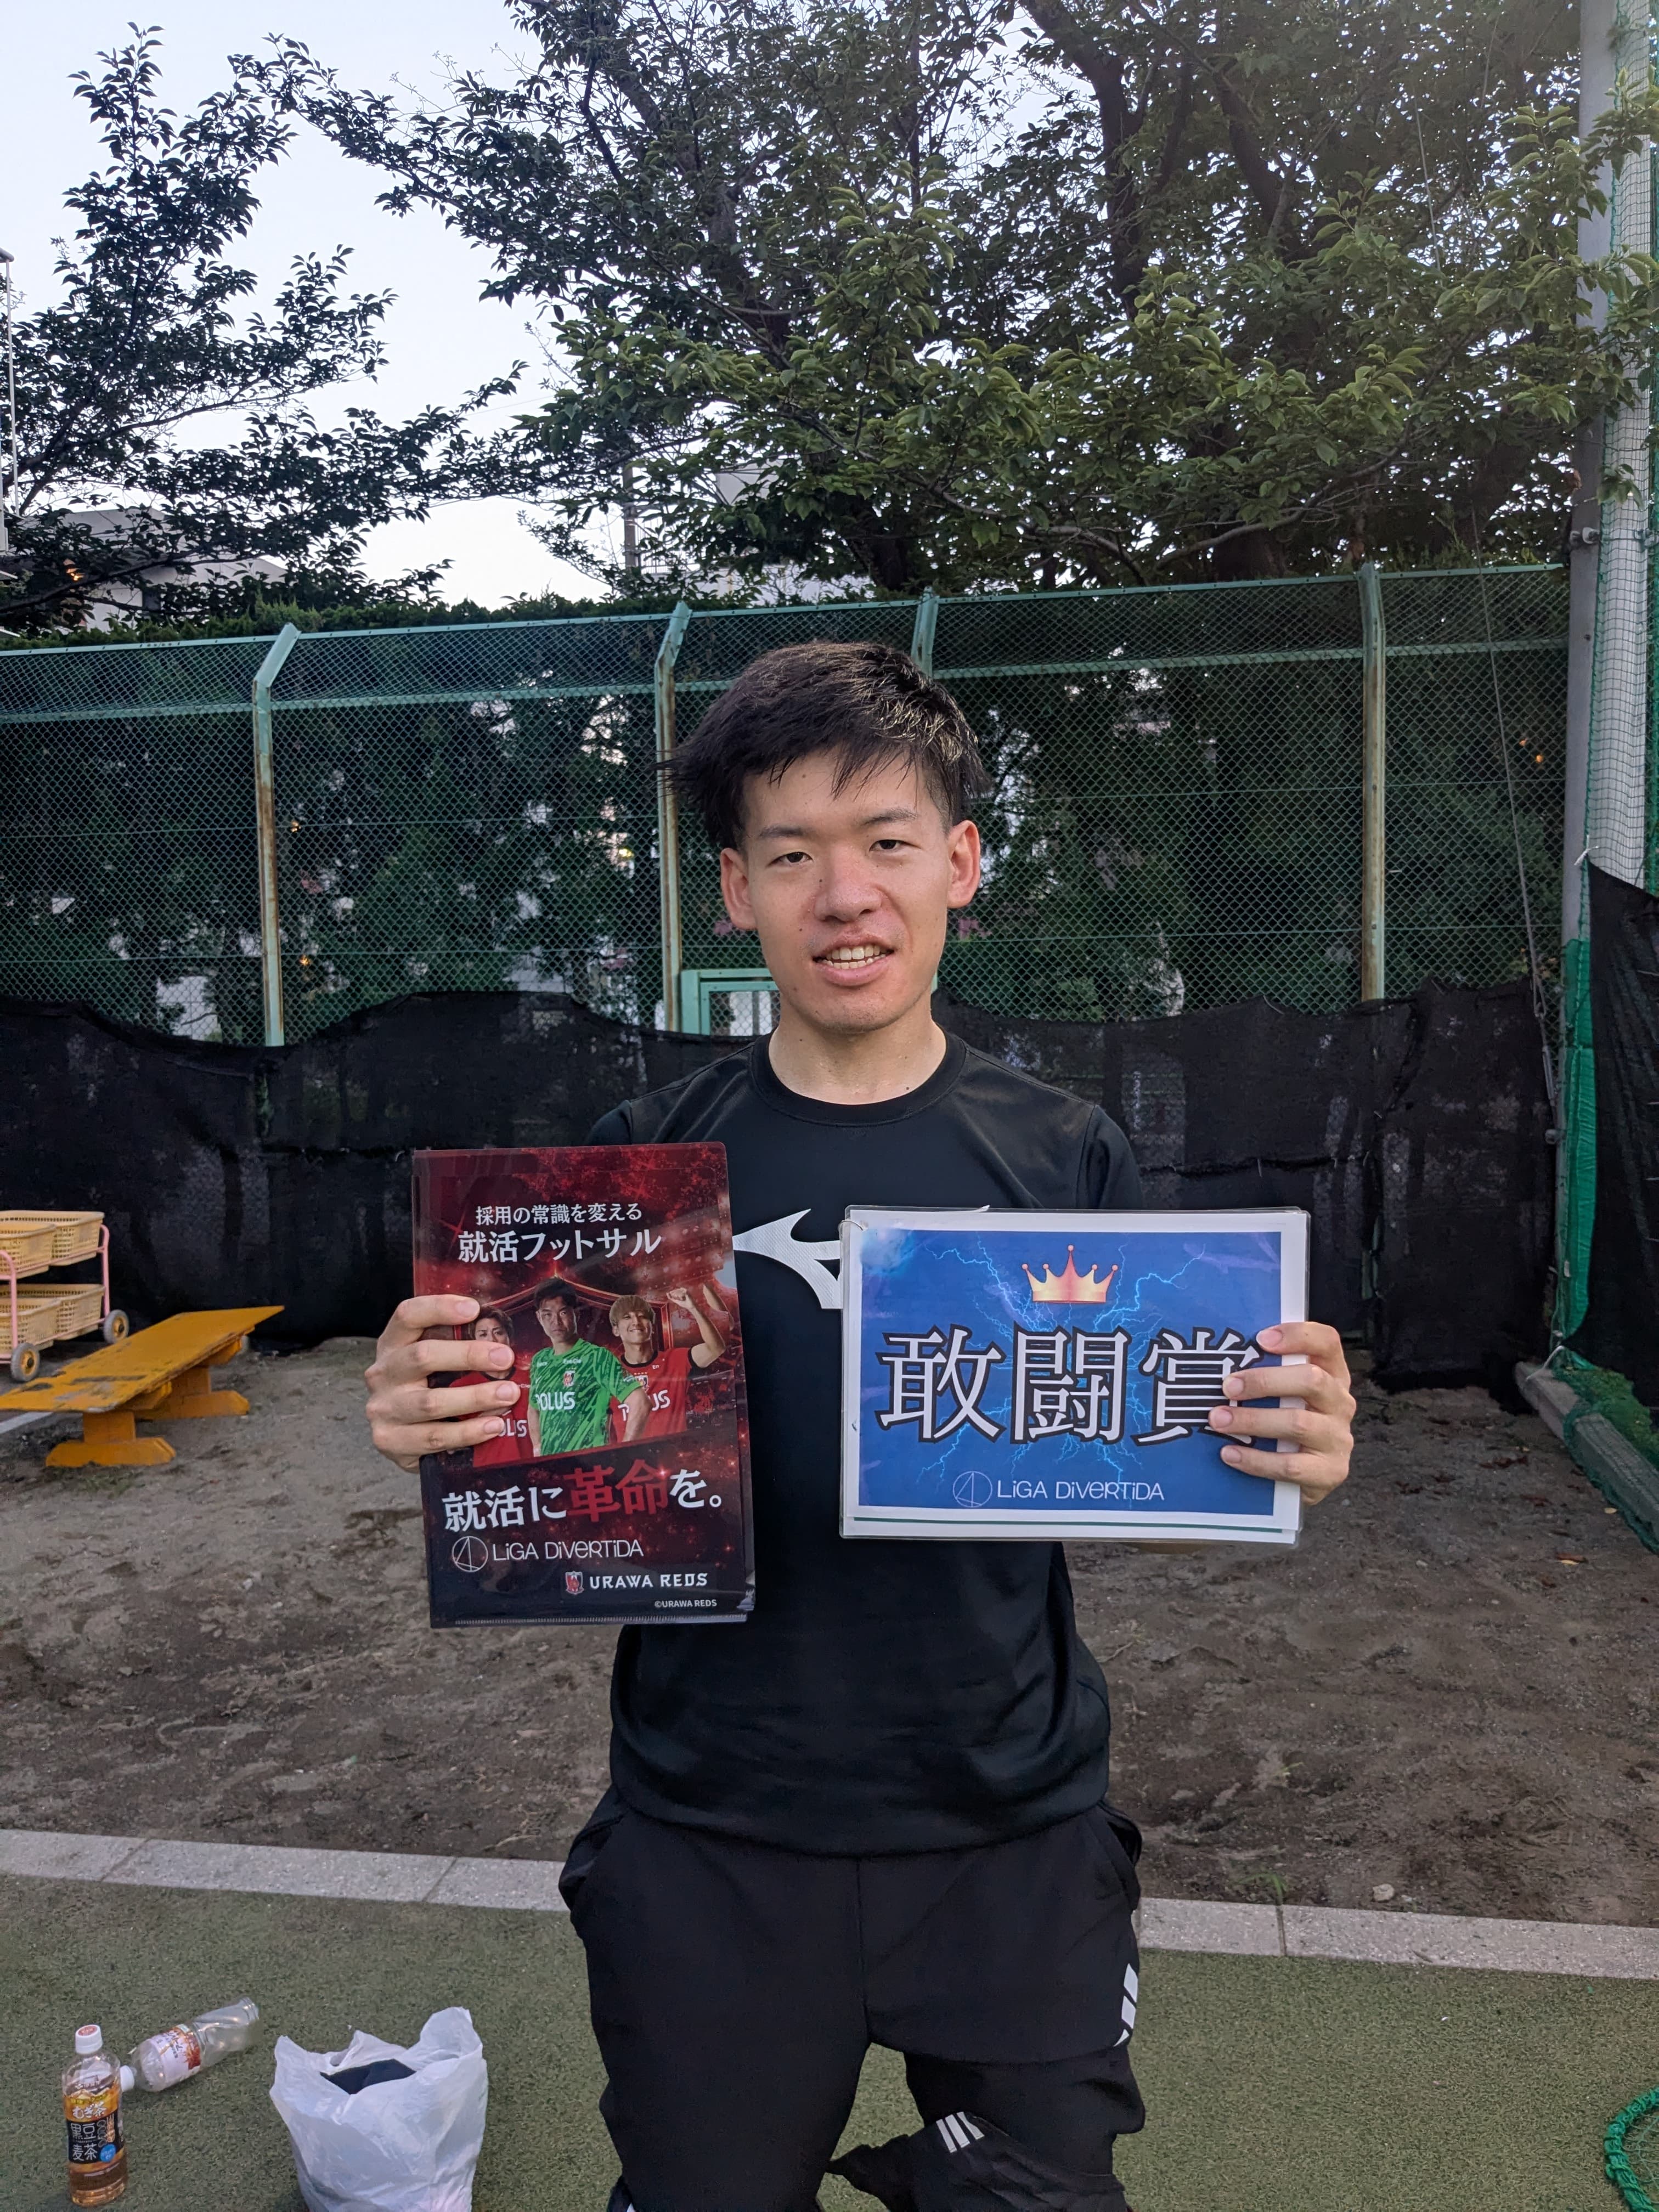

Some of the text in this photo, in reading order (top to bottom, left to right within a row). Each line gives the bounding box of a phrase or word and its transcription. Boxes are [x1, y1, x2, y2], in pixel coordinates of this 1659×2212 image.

[476, 1203, 642, 1226] 採用の常識を変える
[458, 1228, 662, 1263] 就活フットサル
[876, 1322, 1263, 1446] 敢闘賞
[442, 1459, 722, 1532] 就活に革命を。
[589, 1572, 708, 1589] URAWA REDS
[694, 1599, 718, 1607] REDS
[72, 2101, 107, 2119] むぎ茶
[70, 2122, 97, 2140] 黒豆
[72, 2143, 98, 2162] 麦茶
